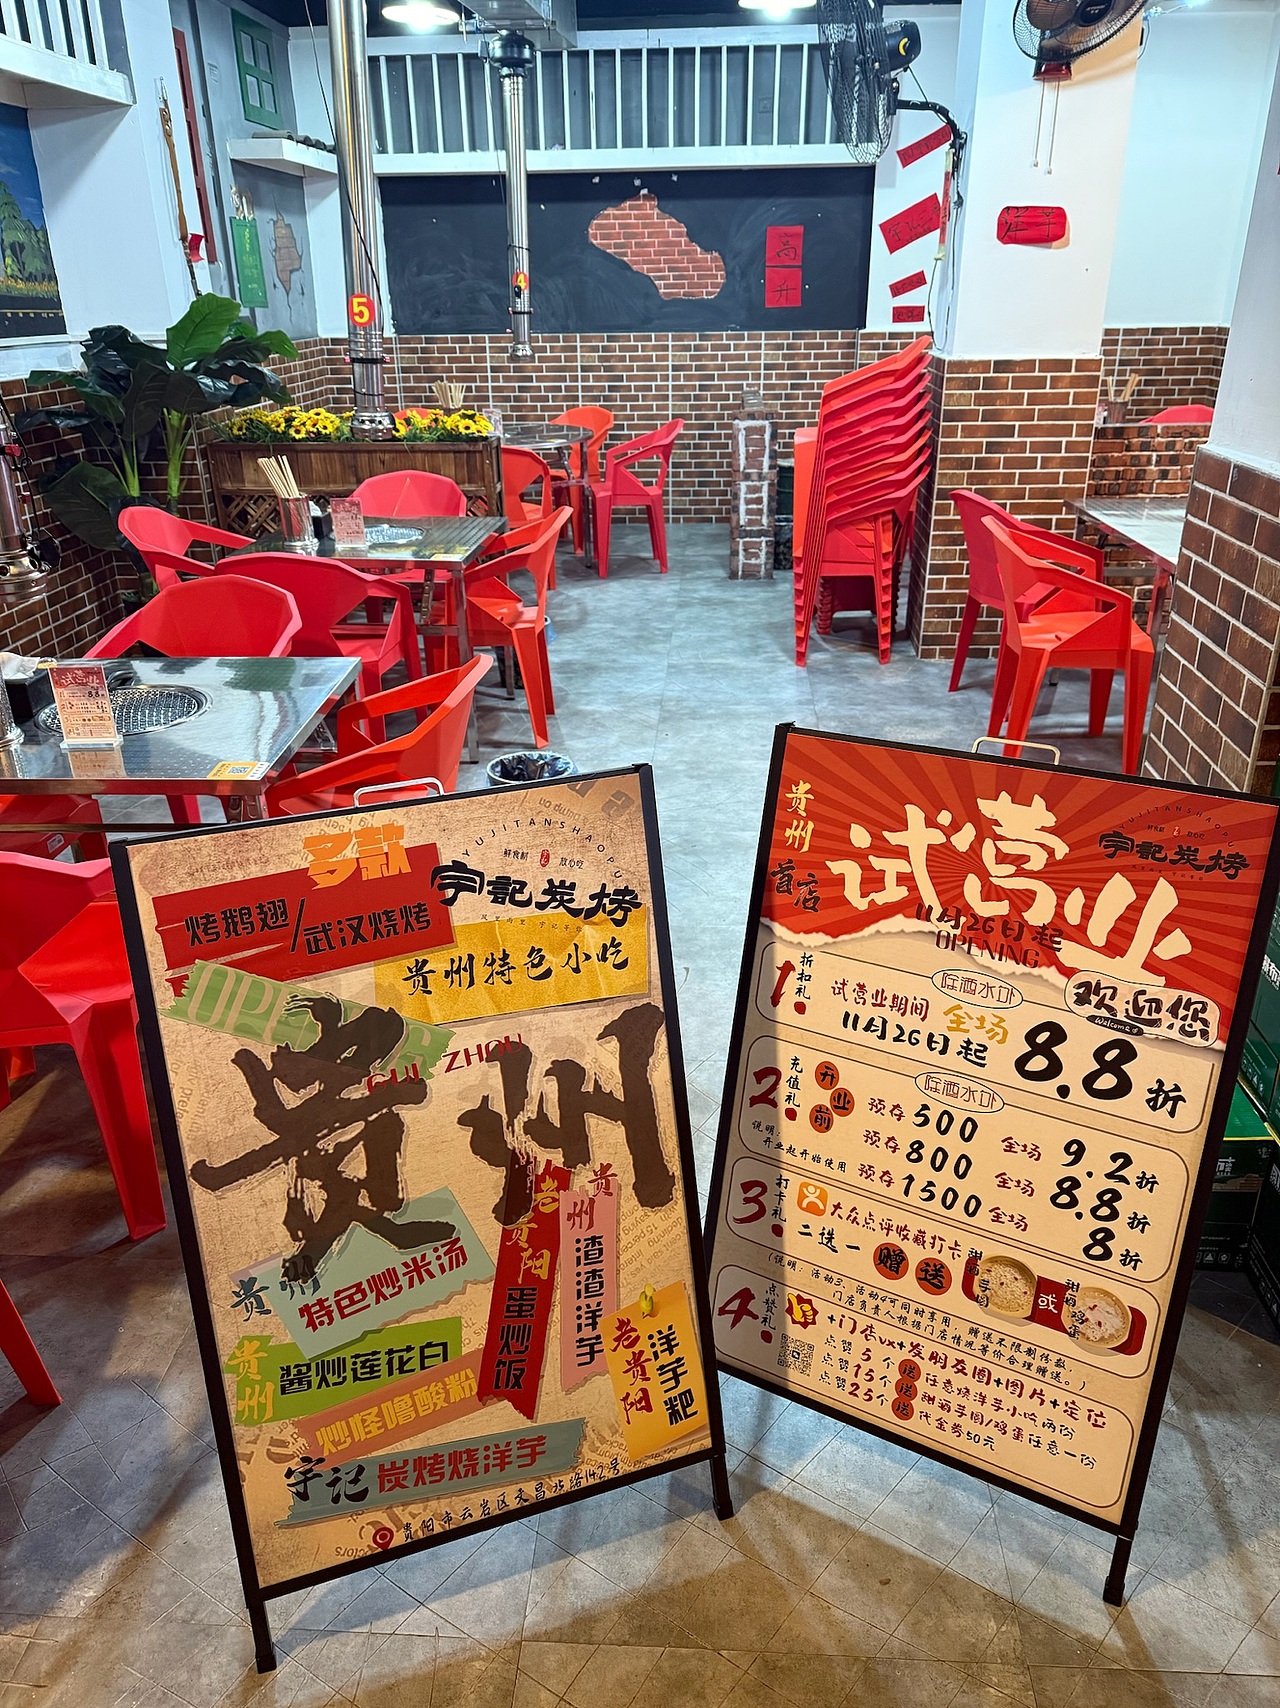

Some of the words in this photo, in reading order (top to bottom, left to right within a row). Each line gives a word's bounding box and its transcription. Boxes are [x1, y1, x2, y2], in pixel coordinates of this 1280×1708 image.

[517, 273, 526, 290] 4
[771, 232, 797, 304] 高升
[352, 298, 369, 324] 5
[785, 779, 815, 853] 贵州
[303, 823, 416, 890] 多款
[461, 817, 623, 881] YUJITANSHAOPU
[558, 857, 585, 869] 放心吃
[770, 858, 822, 913] 首店
[825, 790, 1193, 988] 试营业
[401, 937, 629, 997] 贵州特色小吃
[795, 952, 814, 1000] 折扣礼
[935, 929, 1040, 968] OPENING
[831, 978, 930, 1022] 试营业期间
[941, 972, 1015, 1005] 除酒水外
[1073, 979, 1211, 1042] 欢迎您
[842, 1010, 989, 1068] 11月26日起
[943, 1004, 1009, 1044] 全场
[784, 1056, 803, 1108] 充值礼
[924, 1074, 997, 1110] 除酒水外
[762, 1136, 847, 1173] 开业起开始使用
[1001, 1136, 1042, 1162] 全场
[566, 1162, 618, 1232] 贵州
[771, 1174, 790, 1223] 打卡礼
[994, 1172, 1035, 1197] 全场
[797, 1223, 861, 1254] 二选一
[829, 1201, 963, 1260] 大众点评收藏打卡
[988, 1206, 1029, 1232] 全场
[298, 1236, 468, 1333] 特色炒米汤
[574, 1234, 605, 1368] 渣渣洋芋
[761, 1282, 780, 1331] 点赞礼
[1038, 1293, 1058, 1314] 或
[493, 1286, 538, 1390] 蛋炒饭
[227, 1339, 276, 1422] 贵州
[279, 1341, 450, 1397] 酱炒莲花白
[609, 1317, 654, 1425] 老贵阳
[647, 1323, 699, 1426] 洋芋粑
[315, 1368, 477, 1457] 炒怪噜酸粉
[918, 1410, 997, 1452] 代金券50元
[925, 1371, 1076, 1440] 任意烧洋芋小吃两份
[284, 1455, 370, 1504] 宇记
[377, 1434, 547, 1494] 炭烤烧洋芋
[402, 1457, 621, 1543] 贵阳市云岩区文昌北路142号
